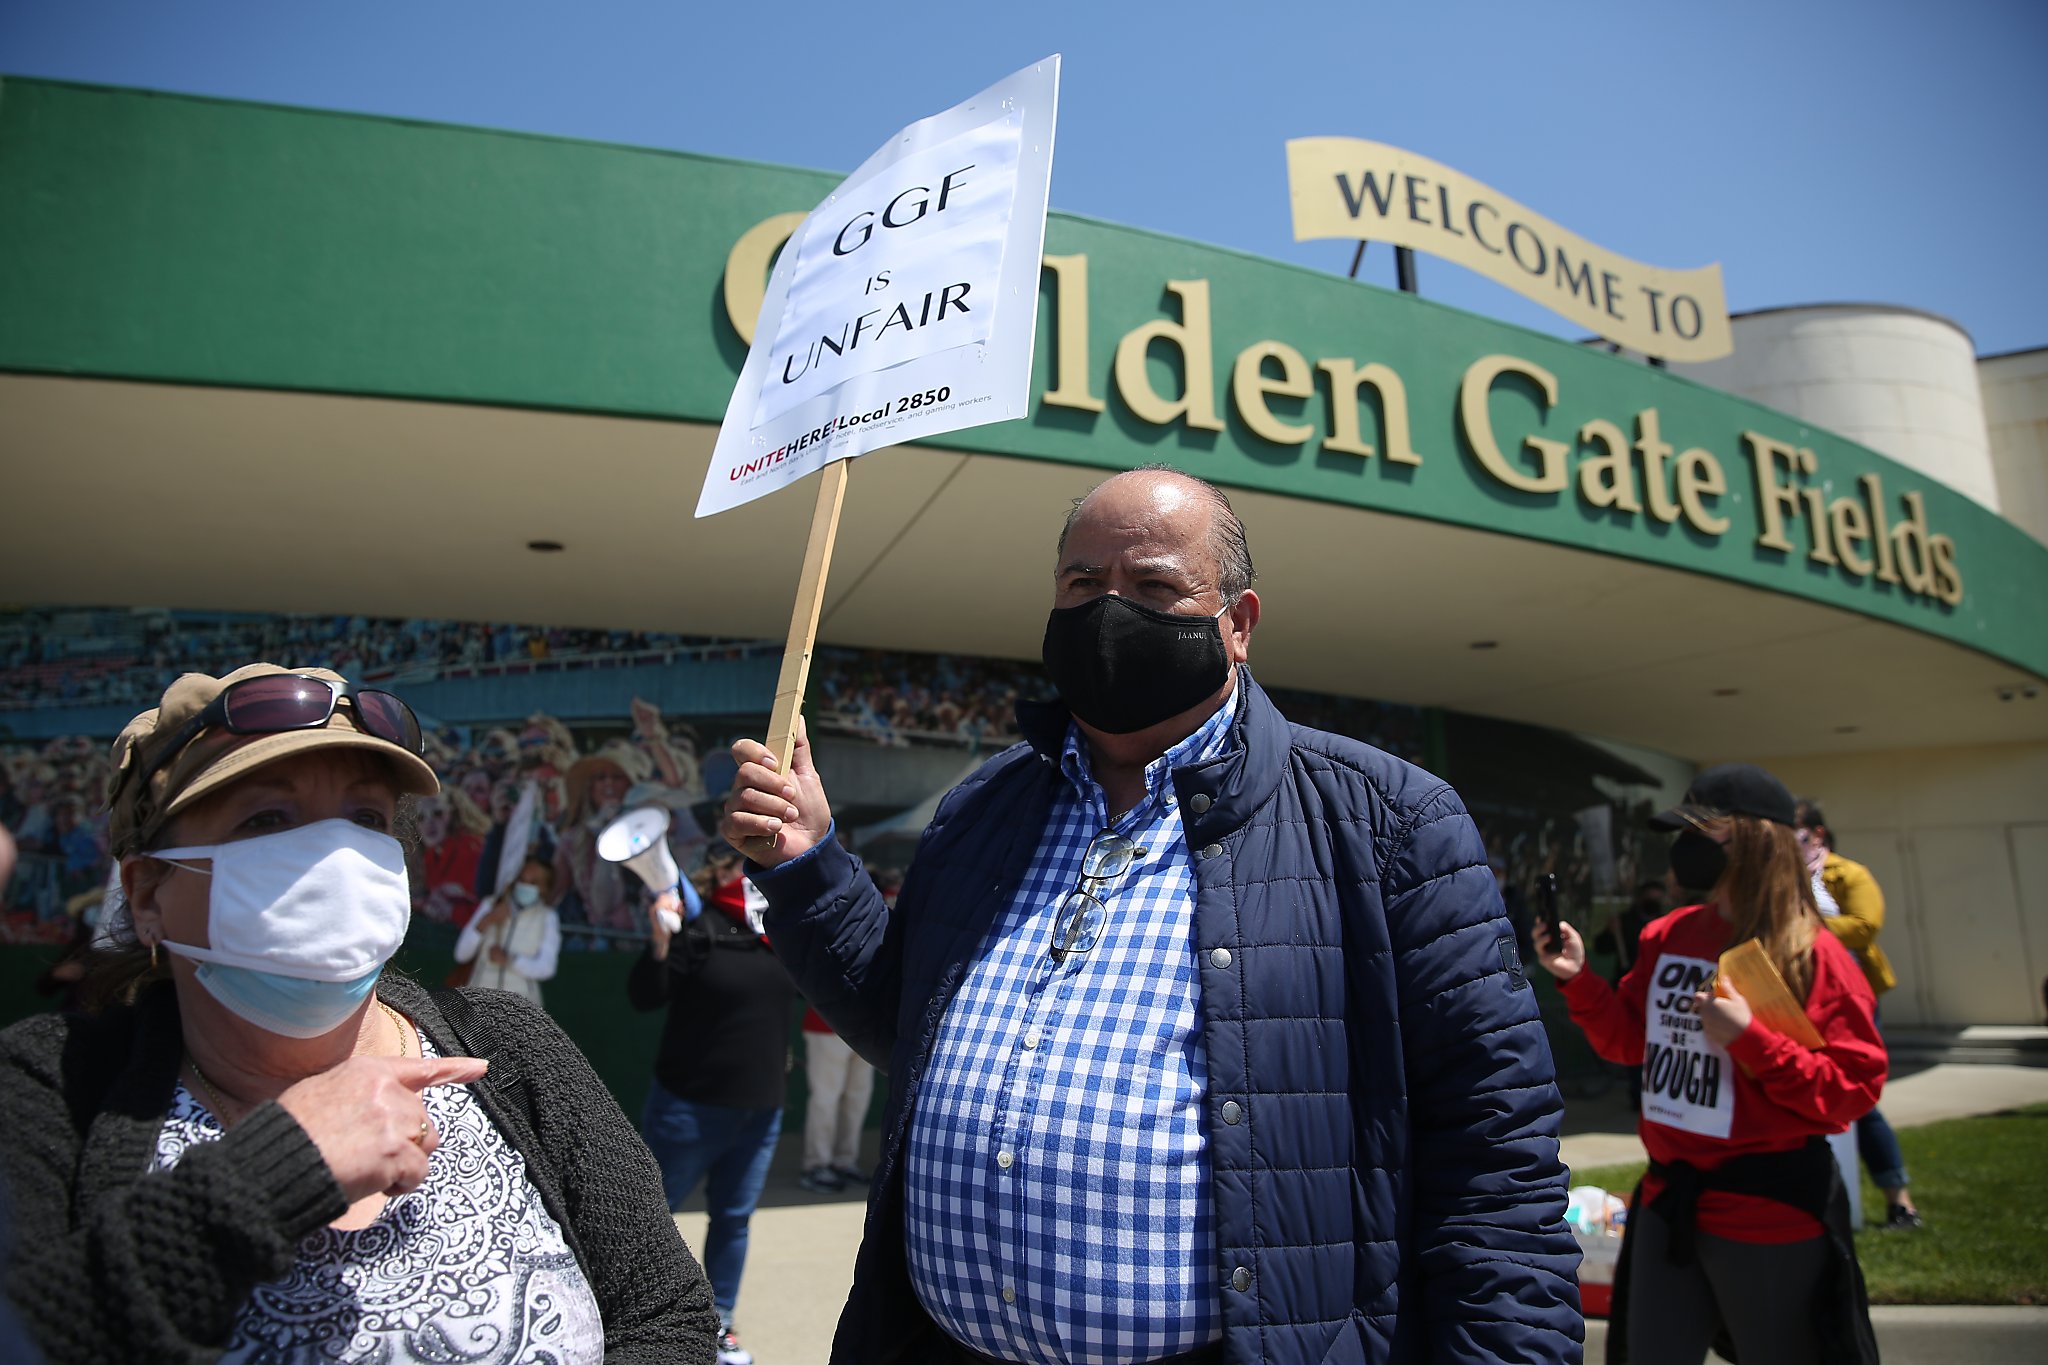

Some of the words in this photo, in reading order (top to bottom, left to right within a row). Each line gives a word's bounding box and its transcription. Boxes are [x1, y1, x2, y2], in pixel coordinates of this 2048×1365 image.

[832, 164, 976, 256] GGF
[1335, 170, 1626, 322] WELCOME
[1639, 286, 1705, 340] TO
[864, 269, 892, 296] IS
[782, 282, 972, 385] UNFAIR
[724, 210, 1423, 466] lden
[1461, 353, 1731, 536] Gate
[1743, 429, 1963, 607] Fields
[838, 402, 891, 430] Local
[896, 386, 951, 414] 2850
[858, 415, 905, 434] foodservice,
[907, 409, 923, 420] and
[925, 401, 956, 417] gaming
[958, 394, 992, 408] workers
[1658, 963, 1714, 993] ON
[1656, 993, 1700, 1014] JO
